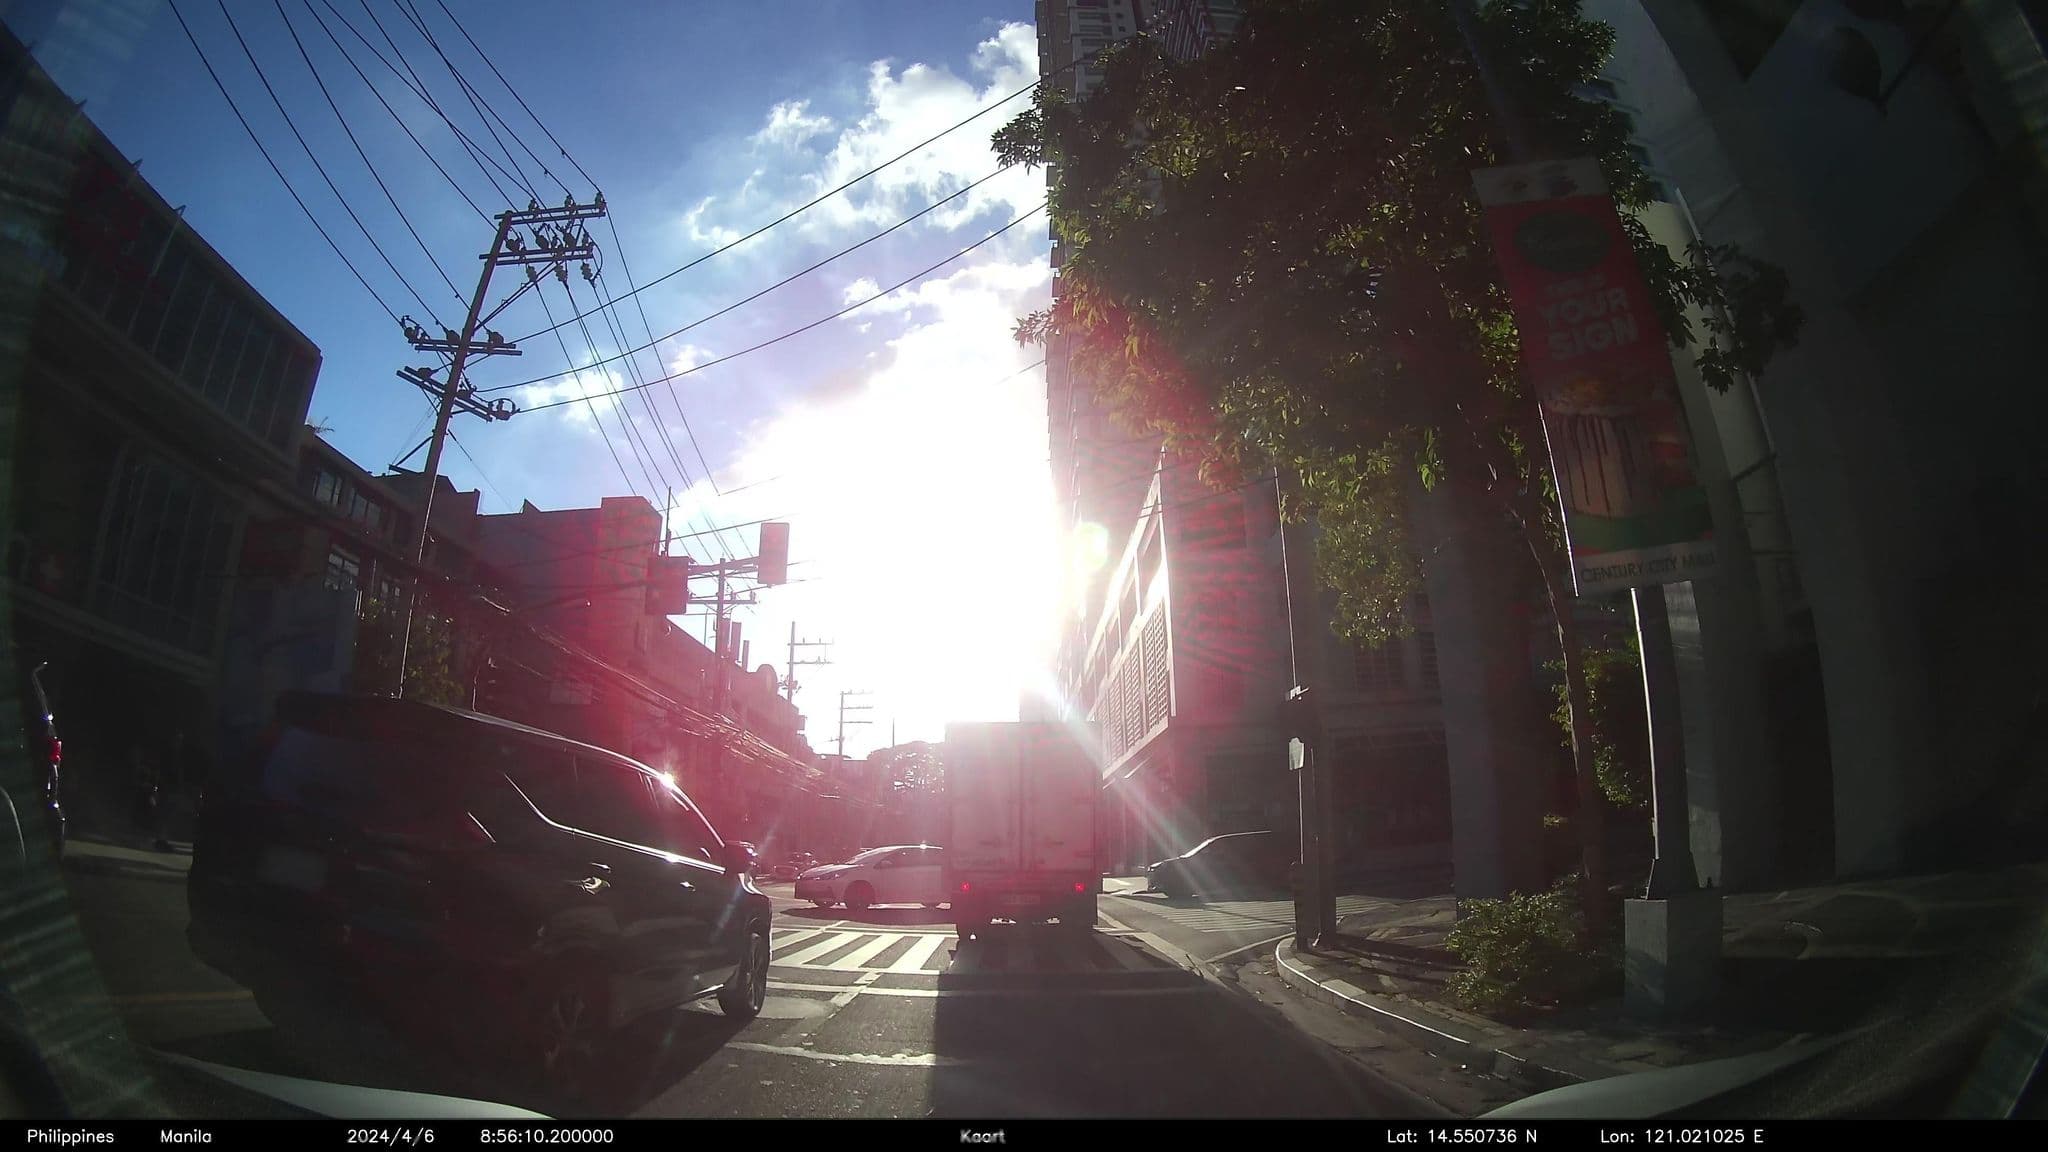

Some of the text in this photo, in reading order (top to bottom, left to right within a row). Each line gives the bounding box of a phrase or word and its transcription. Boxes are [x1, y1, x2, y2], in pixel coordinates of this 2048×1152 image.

[1536, 287, 1632, 330] YOUR
[1548, 313, 1640, 361] SIGN
[1581, 560, 1644, 584] CENTURY
[1648, 556, 1678, 574] CITY
